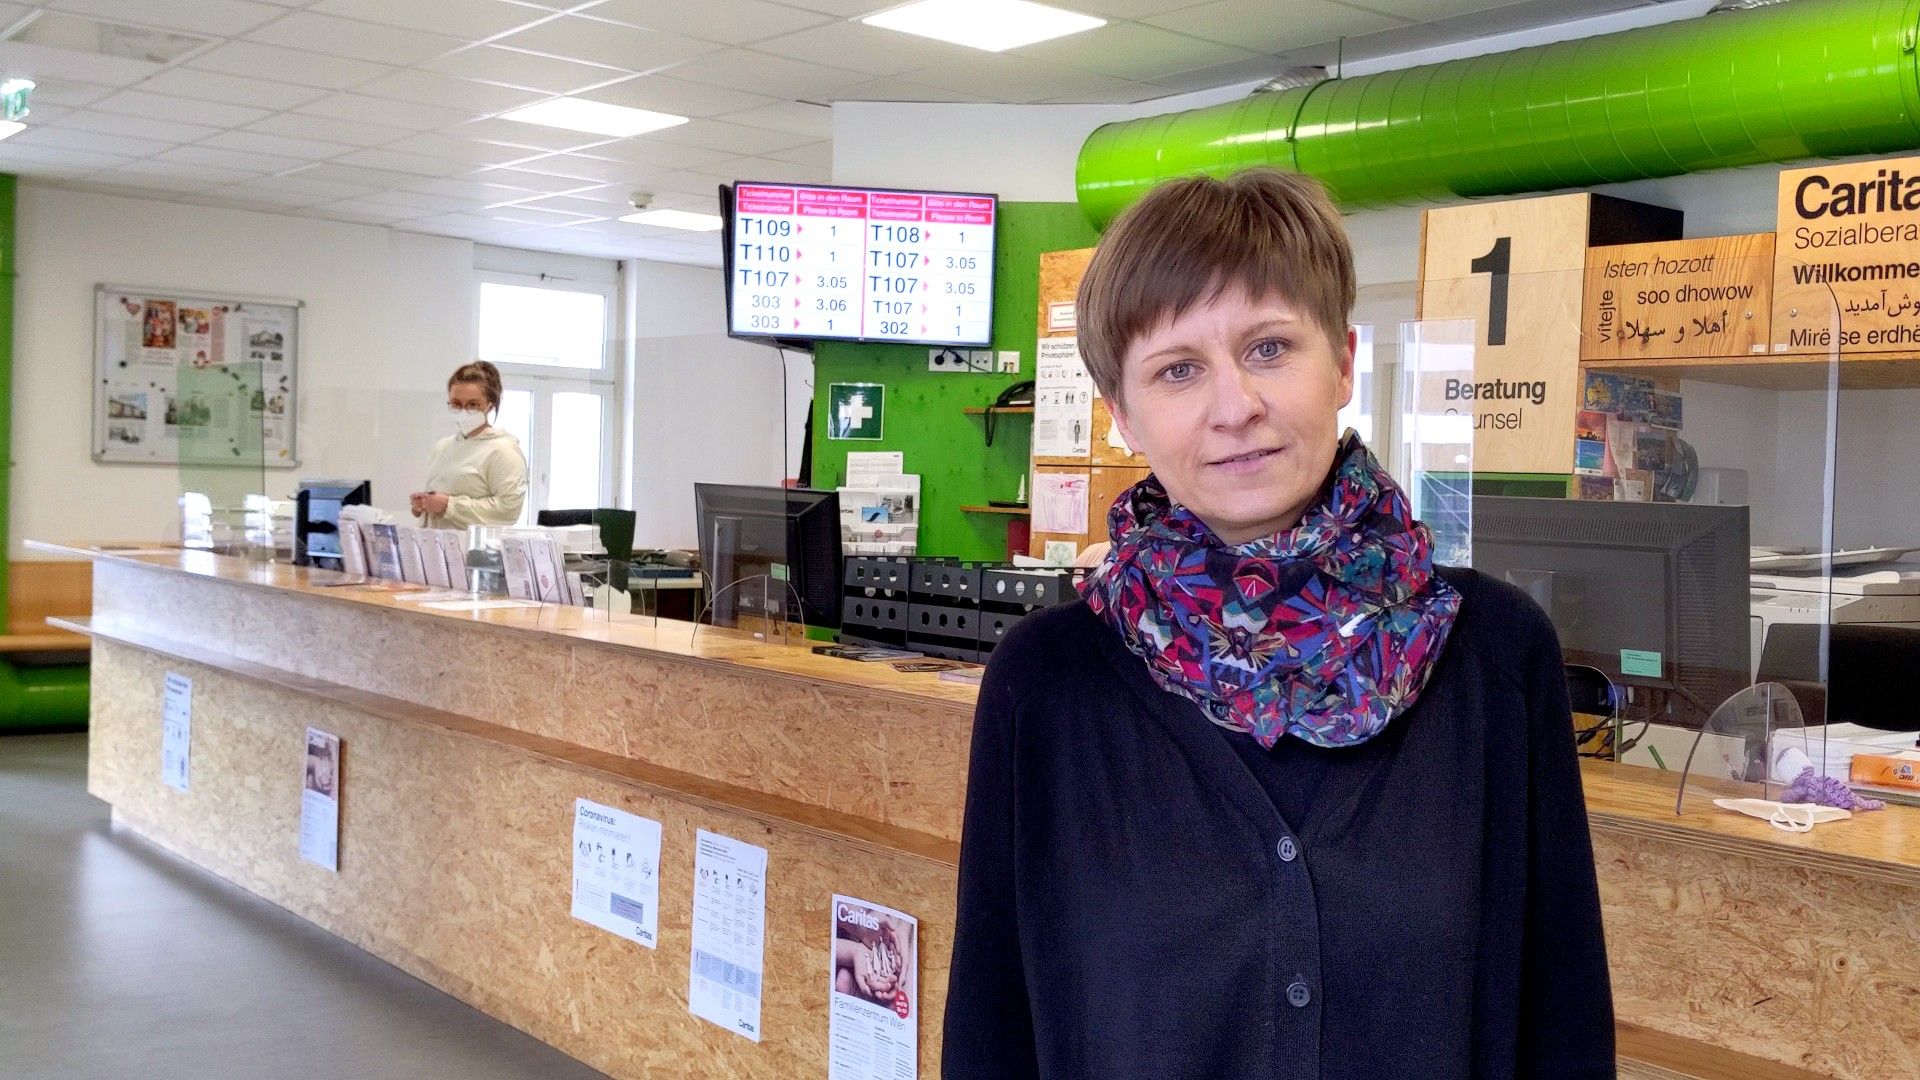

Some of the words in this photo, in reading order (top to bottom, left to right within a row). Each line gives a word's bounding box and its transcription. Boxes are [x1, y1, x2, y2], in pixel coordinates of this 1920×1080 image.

[1795, 169, 1920, 219] Carita
[741, 218, 791, 237] T109
[831, 226, 837, 237] 1
[871, 225, 920, 243] T108
[959, 232, 965, 243] 1
[740, 244, 790, 262] T110
[830, 251, 836, 262] 1
[870, 251, 919, 269] T107
[946, 258, 976, 270] 3.05
[1603, 260, 1648, 278] Isten
[1653, 254, 1715, 275] hozott
[1792, 262, 1920, 284] Willkomme
[739, 269, 789, 287] T107
[816, 276, 847, 289] 3.05
[869, 276, 918, 294] T107
[945, 283, 975, 295] 3.05
[1471, 236, 1511, 346] 1
[1637, 289, 1670, 304] soo
[1676, 284, 1753, 302] dhowow
[751, 295, 780, 309] 303
[816, 298, 847, 312] 3.06
[873, 301, 912, 315] T107
[956, 306, 962, 317] 1
[751, 315, 780, 329] 303
[828, 320, 833, 331] 1
[1598, 289, 1616, 343] vítejte
[880, 321, 909, 335] 302
[955, 326, 961, 337] 1
[1790, 328, 1831, 346] Mirë
[1840, 331, 1861, 346] se
[1445, 379, 1546, 405] Beratung
[1445, 408, 1523, 430] unsel
[836, 903, 880, 931] Caritas
